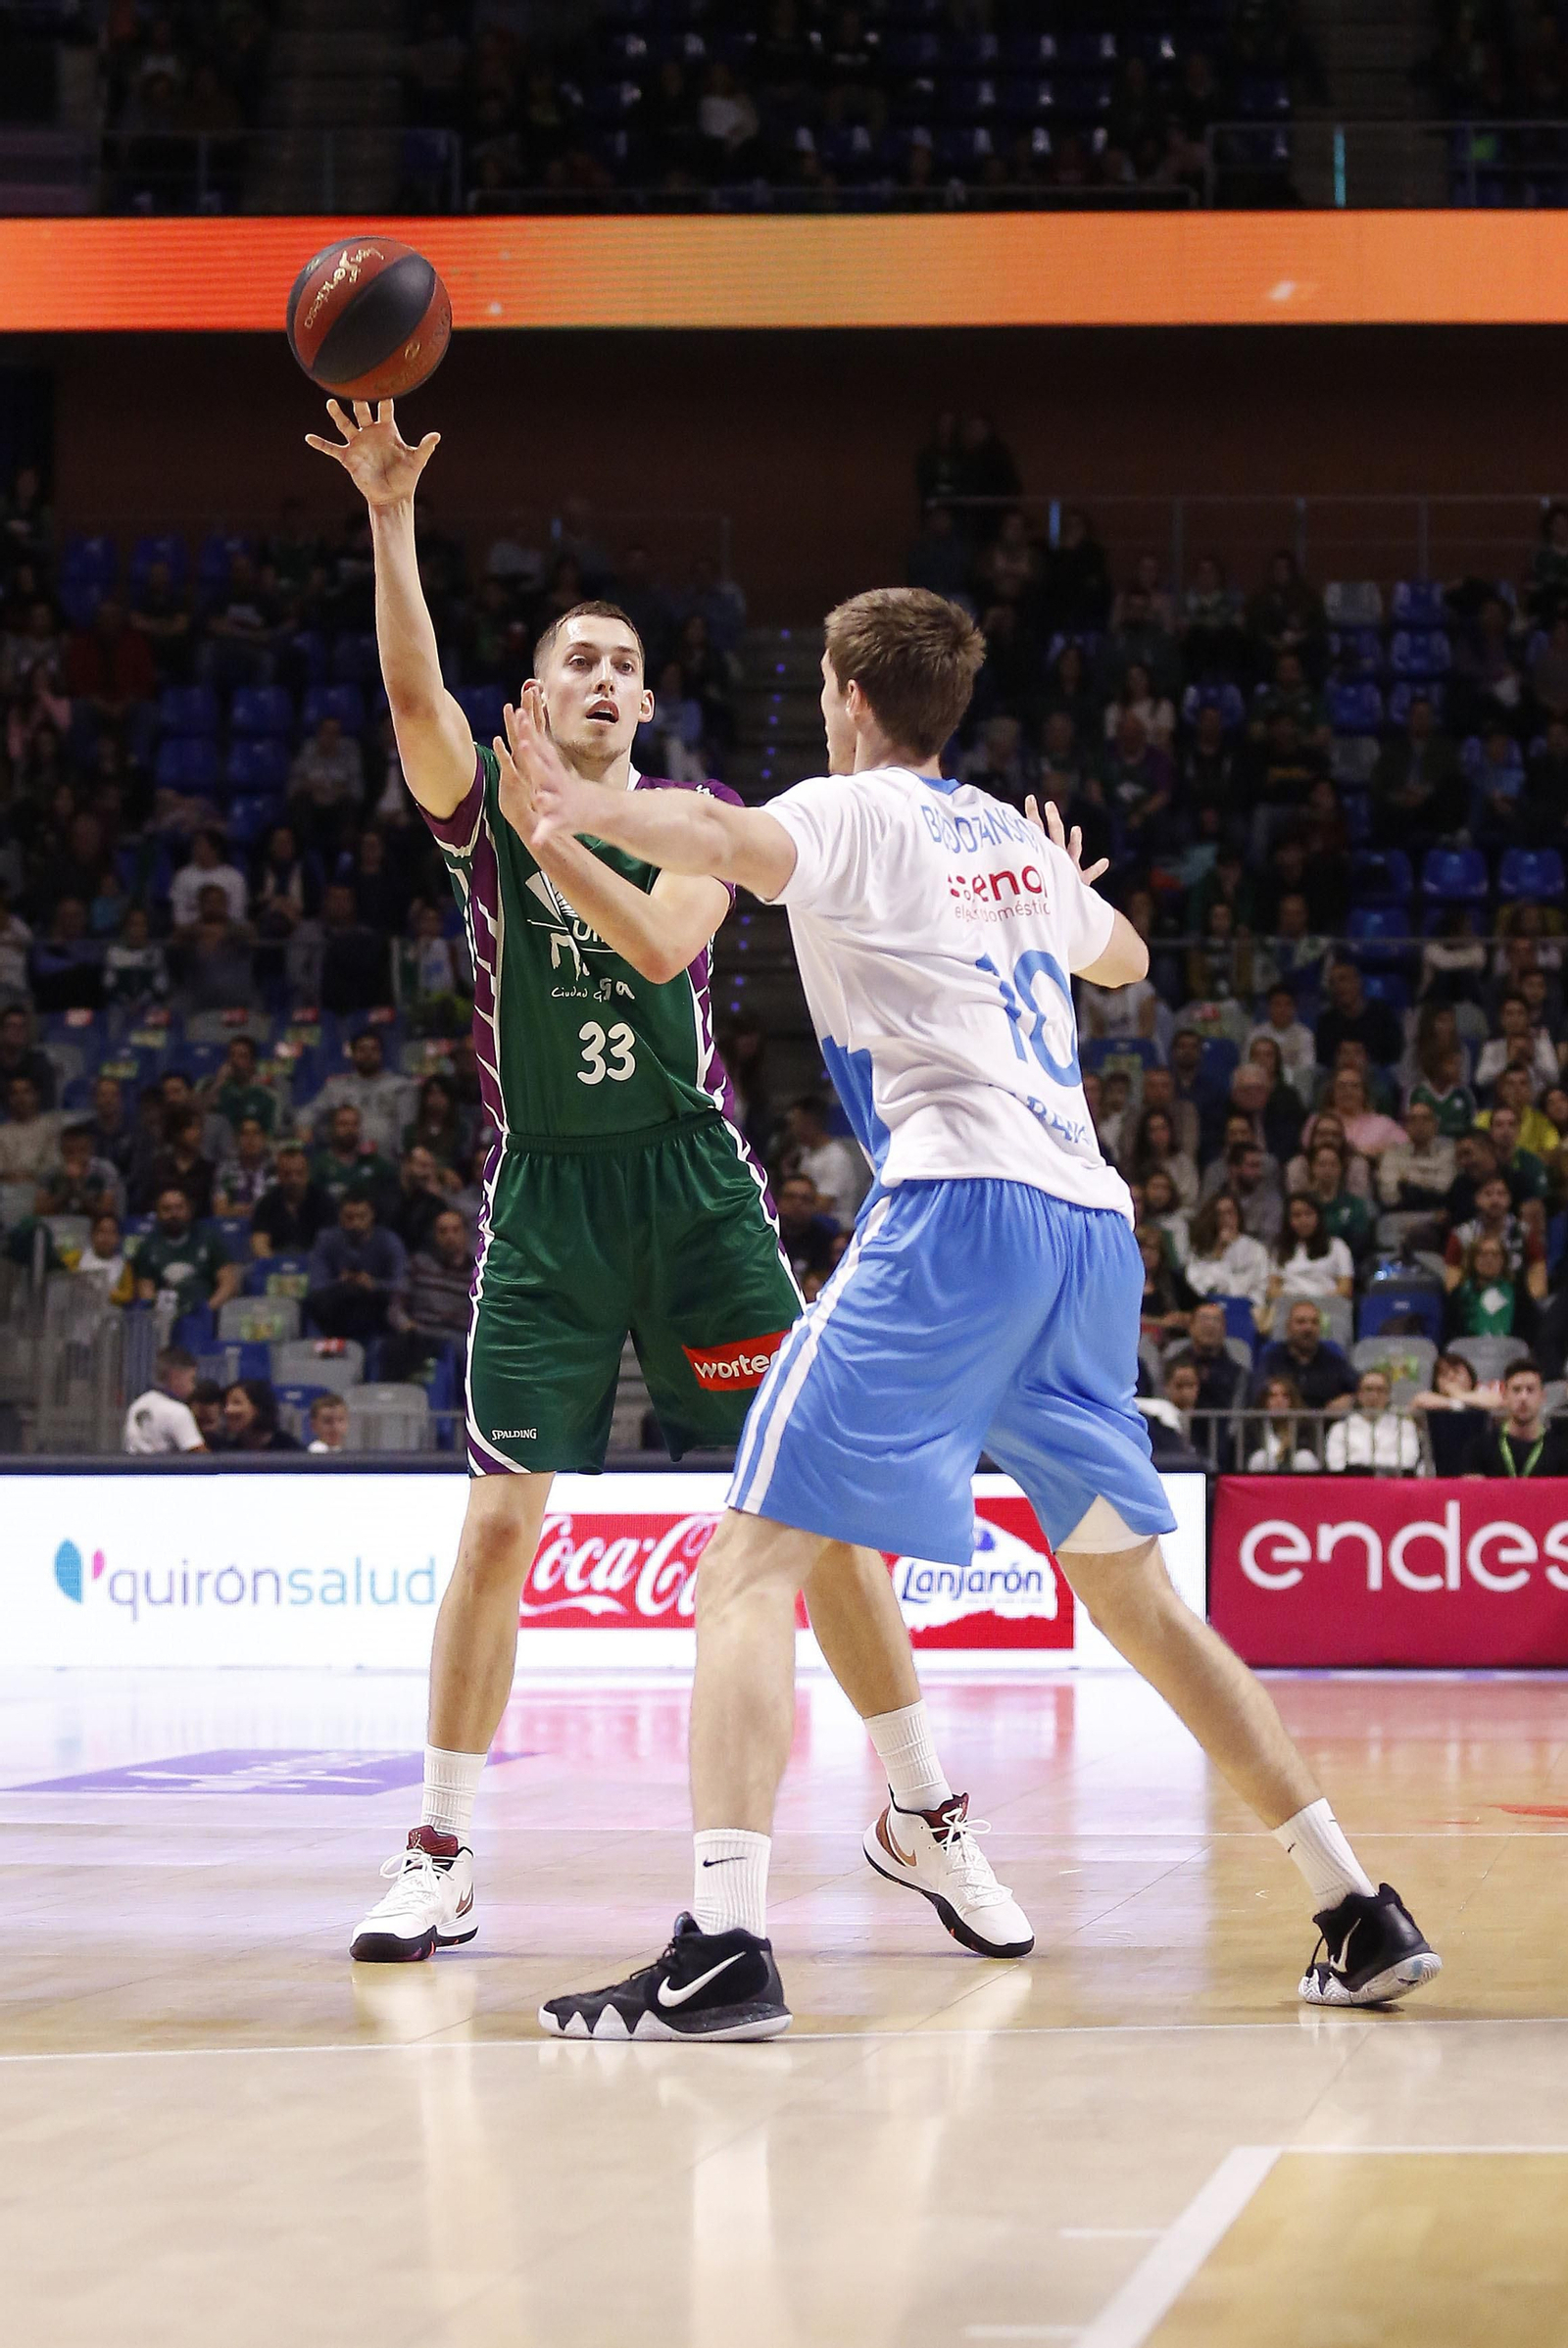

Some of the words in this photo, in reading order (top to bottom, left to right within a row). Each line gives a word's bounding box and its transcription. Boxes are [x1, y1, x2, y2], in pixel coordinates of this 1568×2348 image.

[551, 985, 588, 999] Ciudad
[975, 949, 1083, 1088] 10
[576, 1020, 637, 1085] 33
[491, 1428, 537, 1441] SPALDING
[109, 1555, 438, 1623] quirónsalud
[902, 1561, 1043, 1603] Lanjarón
